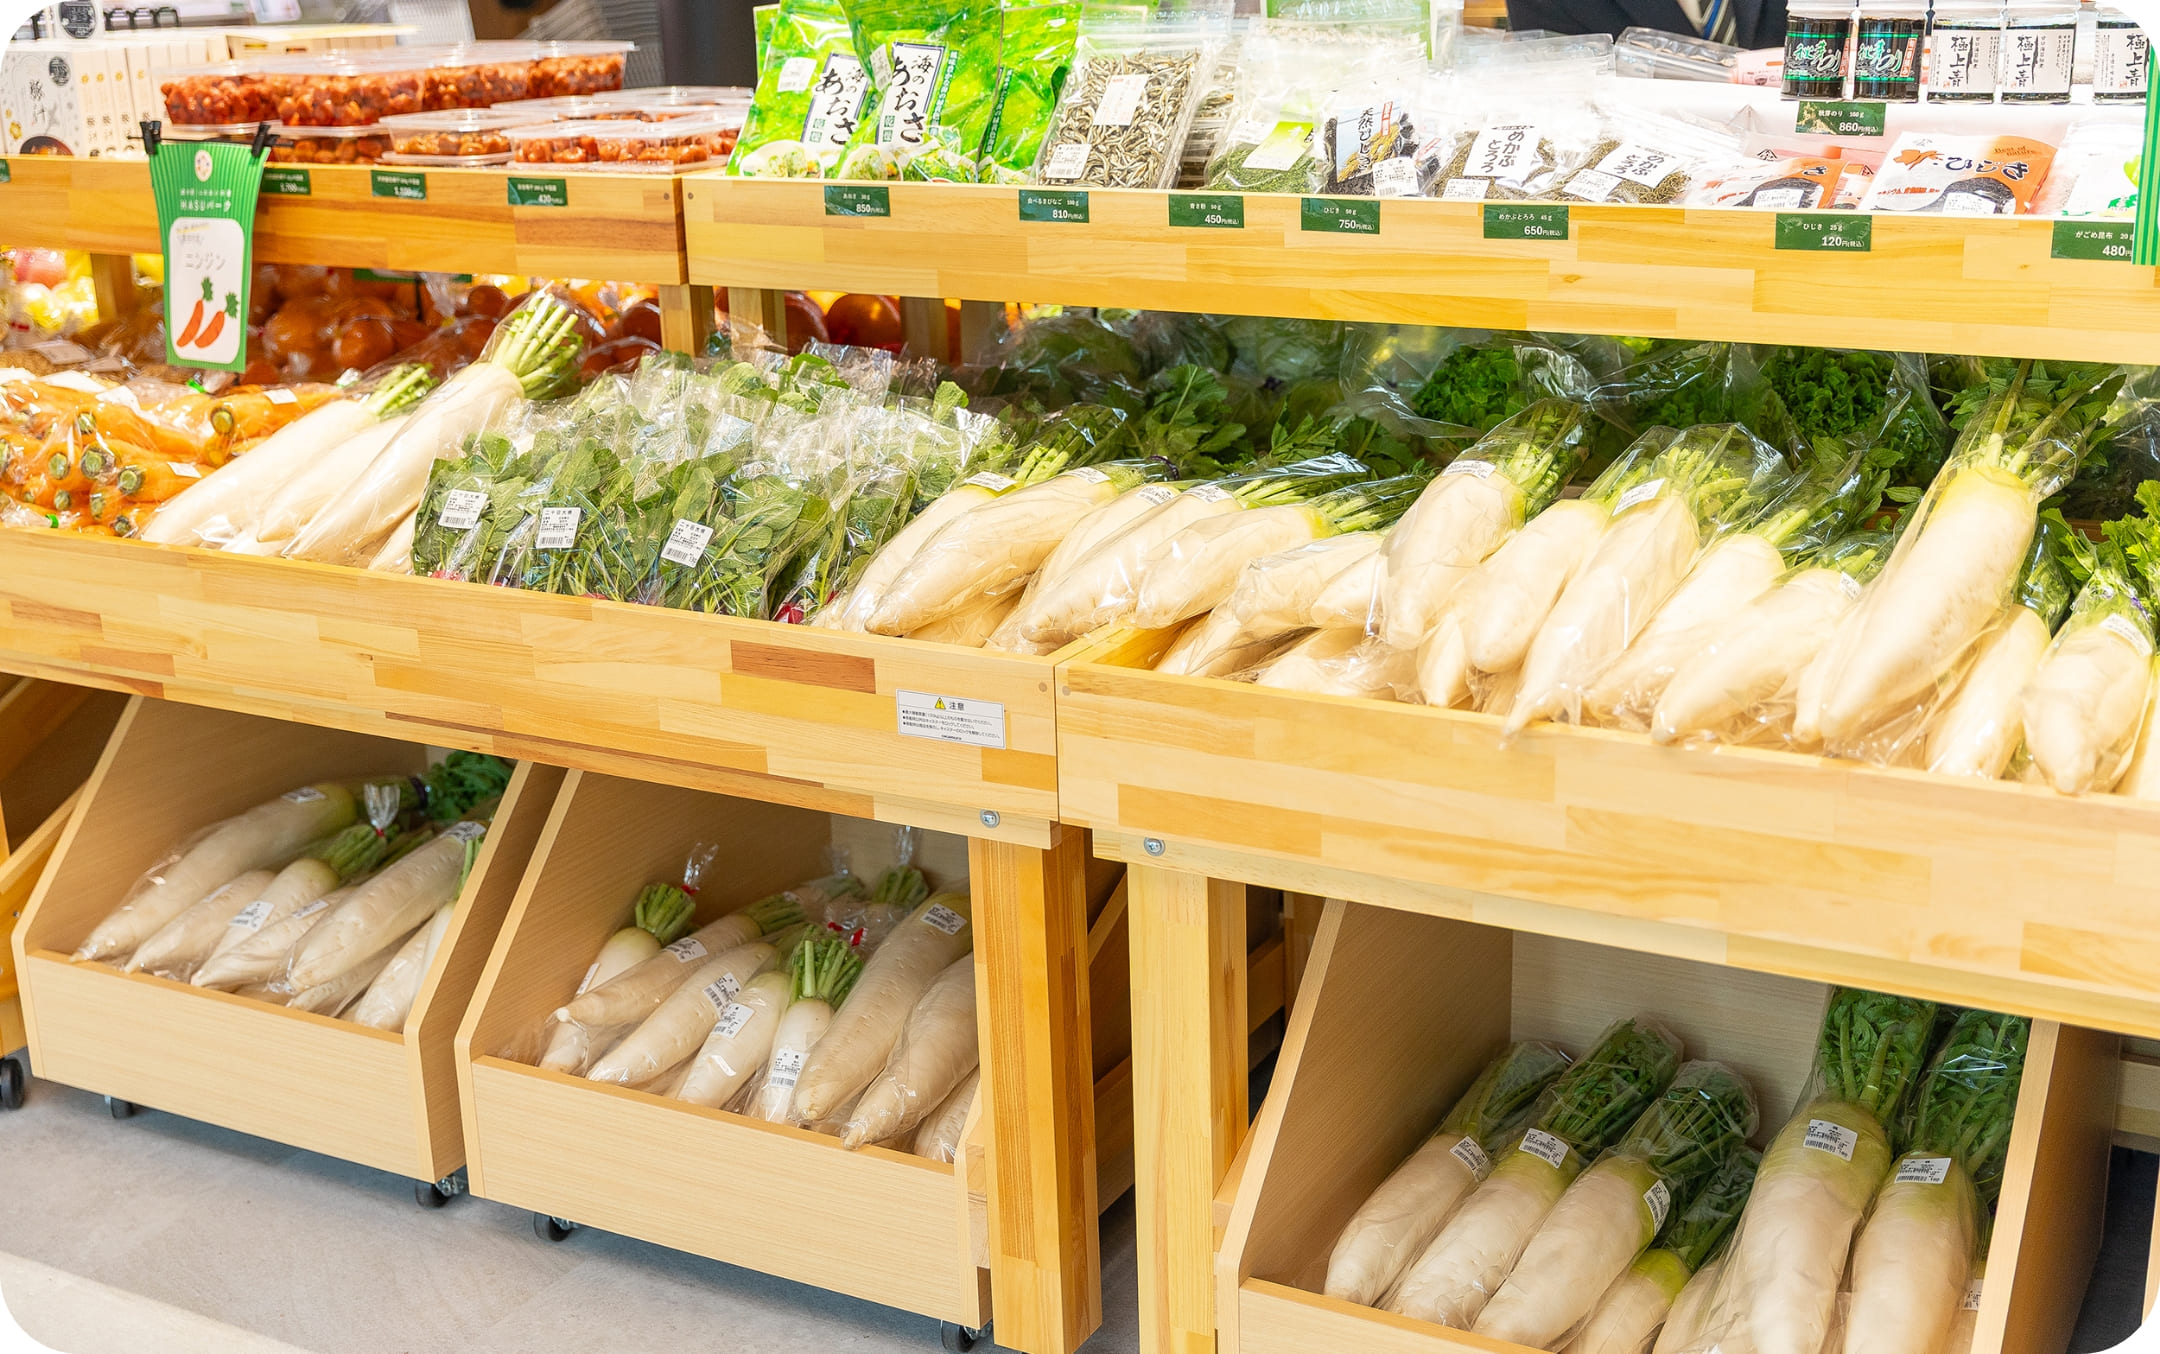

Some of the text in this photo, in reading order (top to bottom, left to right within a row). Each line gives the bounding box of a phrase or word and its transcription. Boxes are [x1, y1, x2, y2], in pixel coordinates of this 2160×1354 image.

[812, 67, 856, 145] あおさ
[892, 56, 925, 143] あおさ
[1481, 139, 1502, 174] とろろ
[1498, 131, 1525, 168] めかぶ
[1499, 213, 1535, 221] めかぶとろろ
[1803, 223, 1823, 231] ひじき
[2075, 230, 2113, 240] がごめ昆布
[949, 701, 965, 711] 注意
